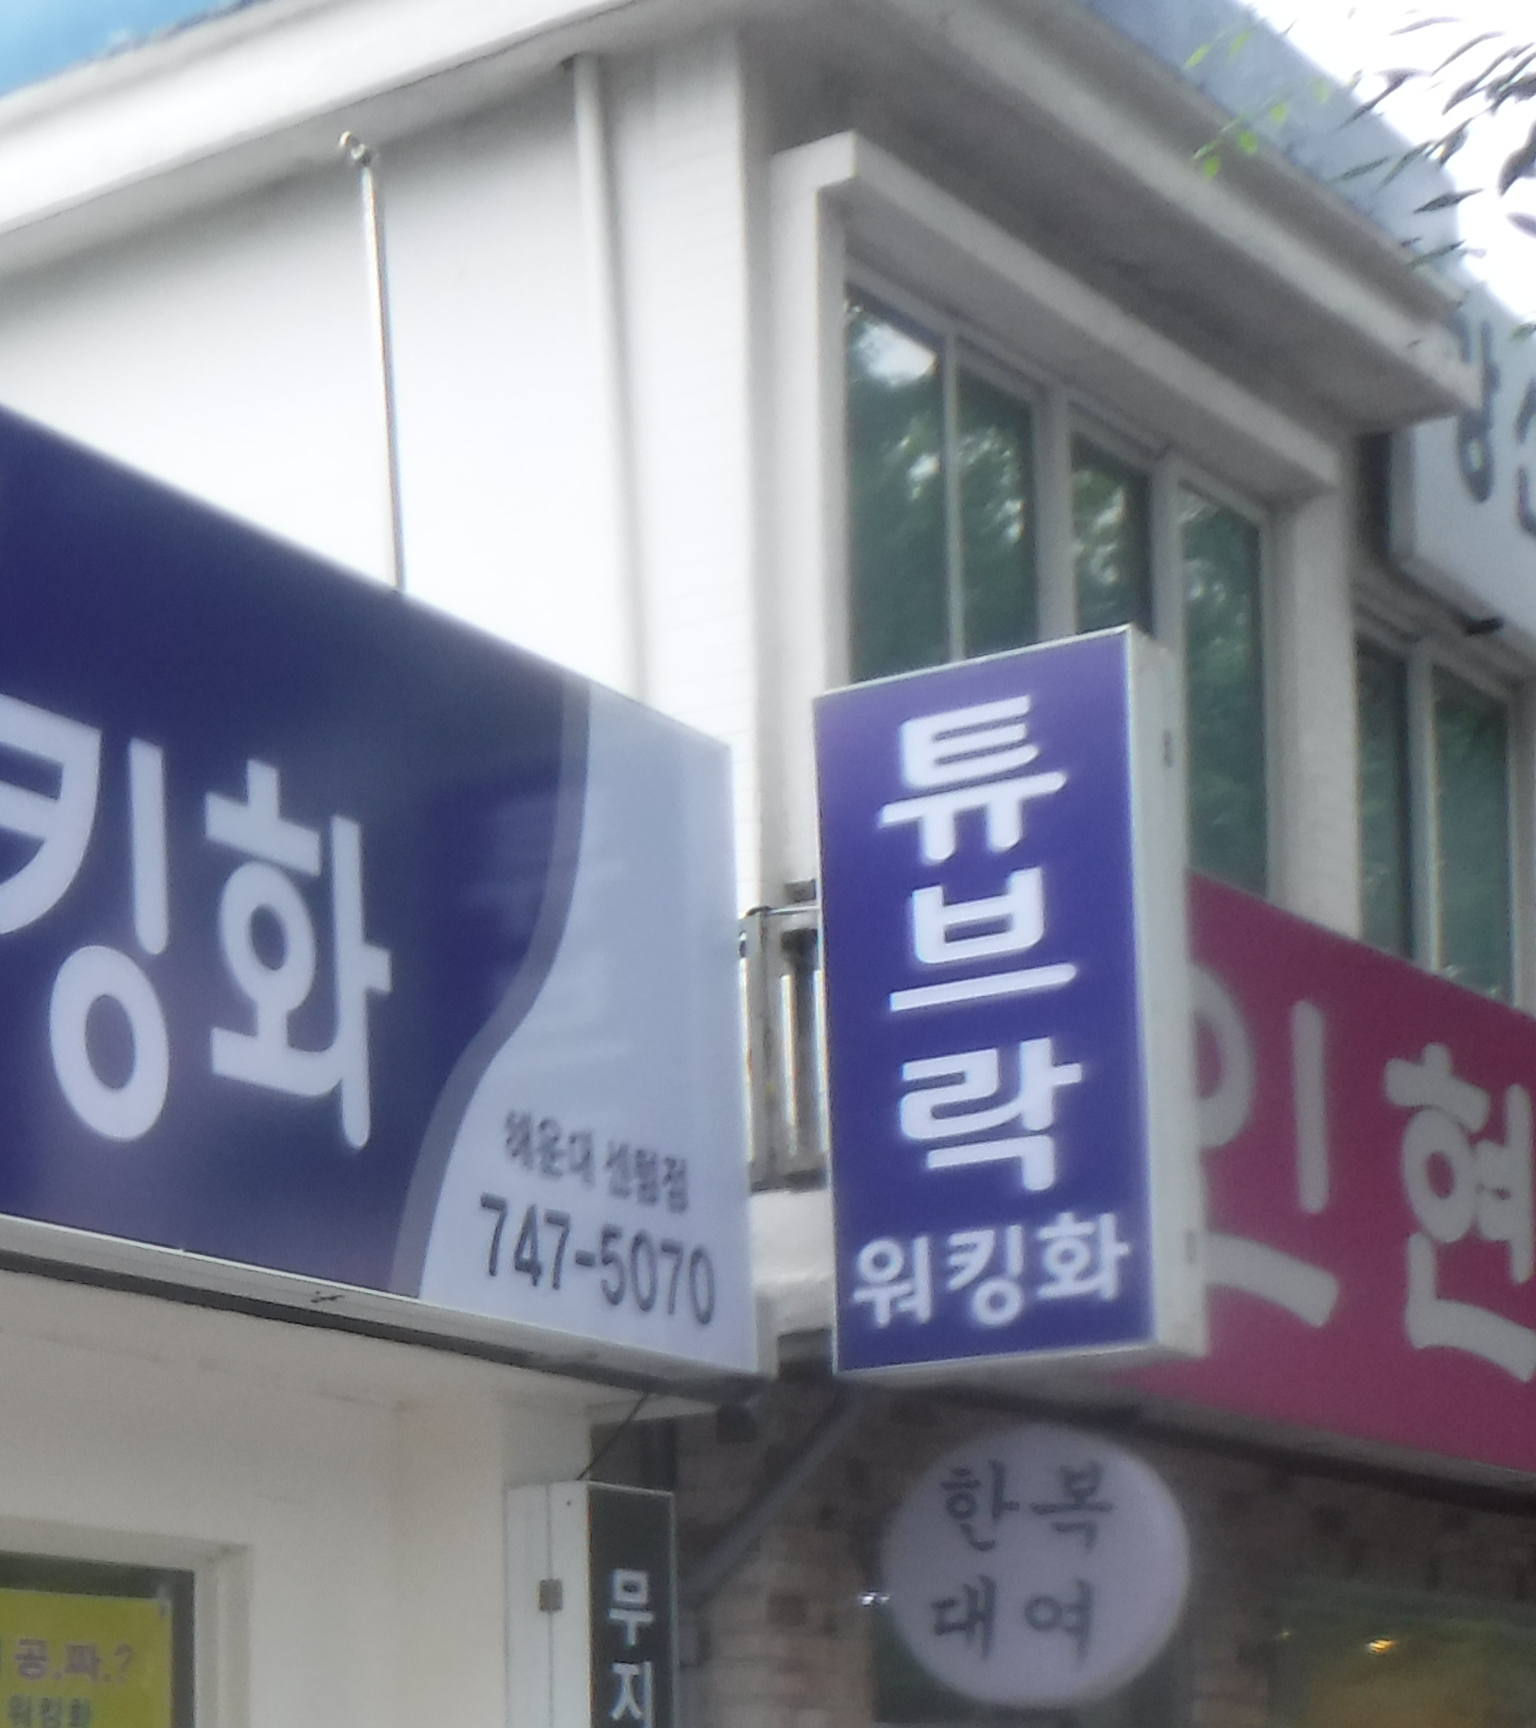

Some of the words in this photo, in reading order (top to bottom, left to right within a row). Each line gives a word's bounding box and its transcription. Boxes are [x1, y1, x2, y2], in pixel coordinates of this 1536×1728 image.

[878, 694, 1084, 1193] 튜브락
[479, 1191, 716, 1325] 747-5070
[852, 1210, 1131, 1327] 워킹화
[939, 1458, 1114, 1552] 한복
[931, 1573, 1094, 1662] 대여
